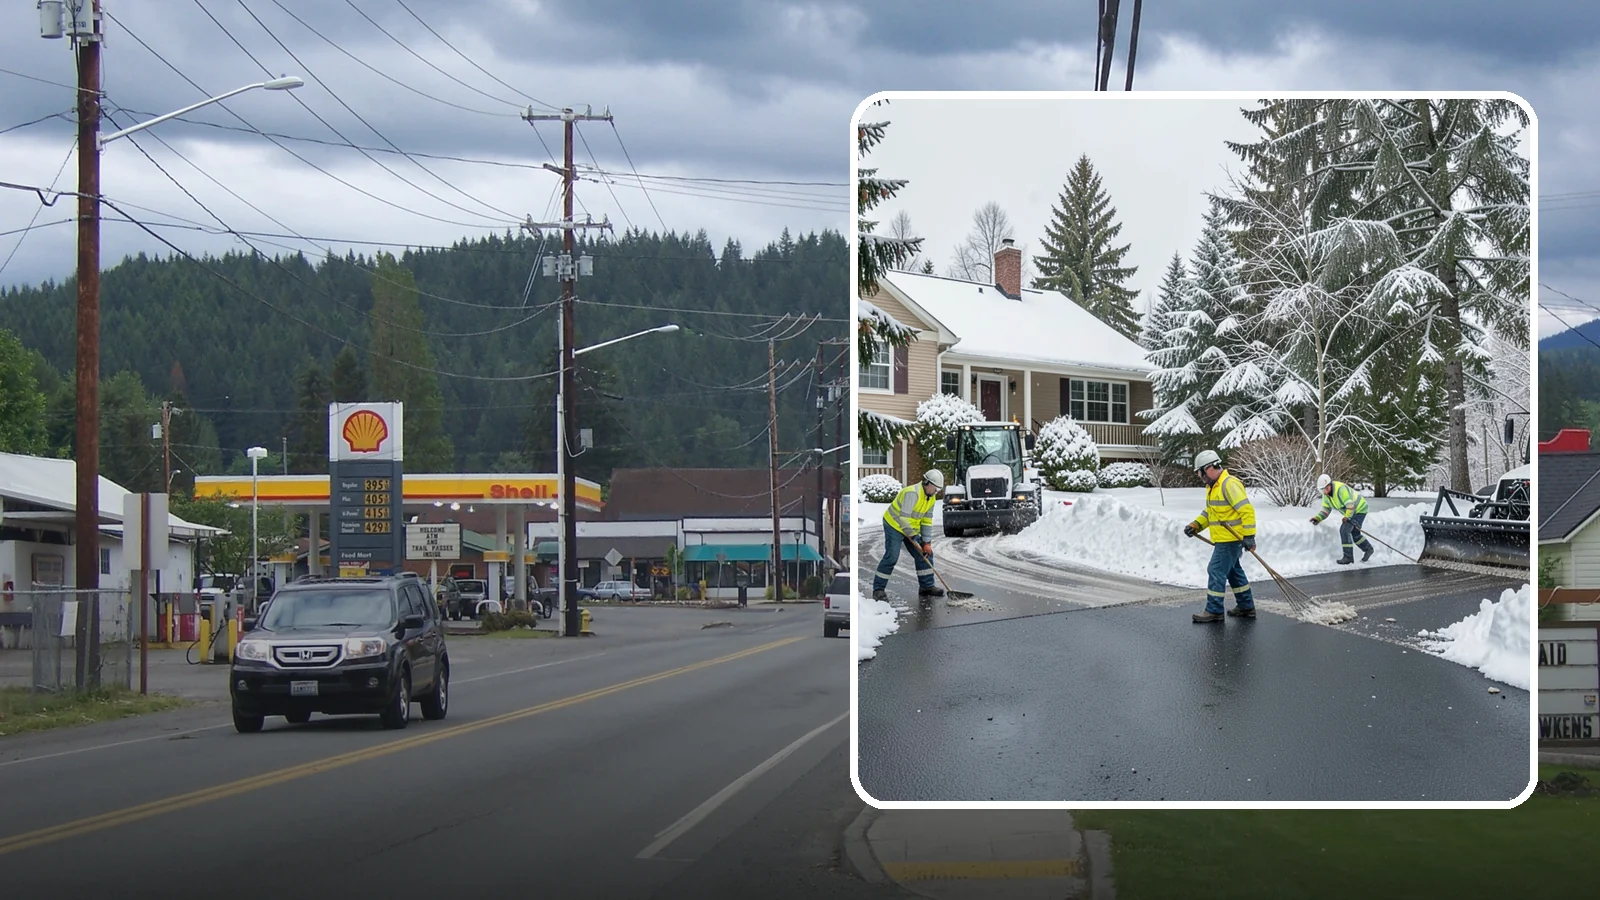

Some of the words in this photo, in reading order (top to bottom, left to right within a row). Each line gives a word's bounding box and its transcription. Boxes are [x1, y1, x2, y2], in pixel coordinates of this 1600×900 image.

[366, 480, 383, 490] 395
[490, 484, 547, 499] Shell
[366, 494, 383, 504] 405
[366, 508, 383, 518] 415
[366, 522, 383, 532] 429
